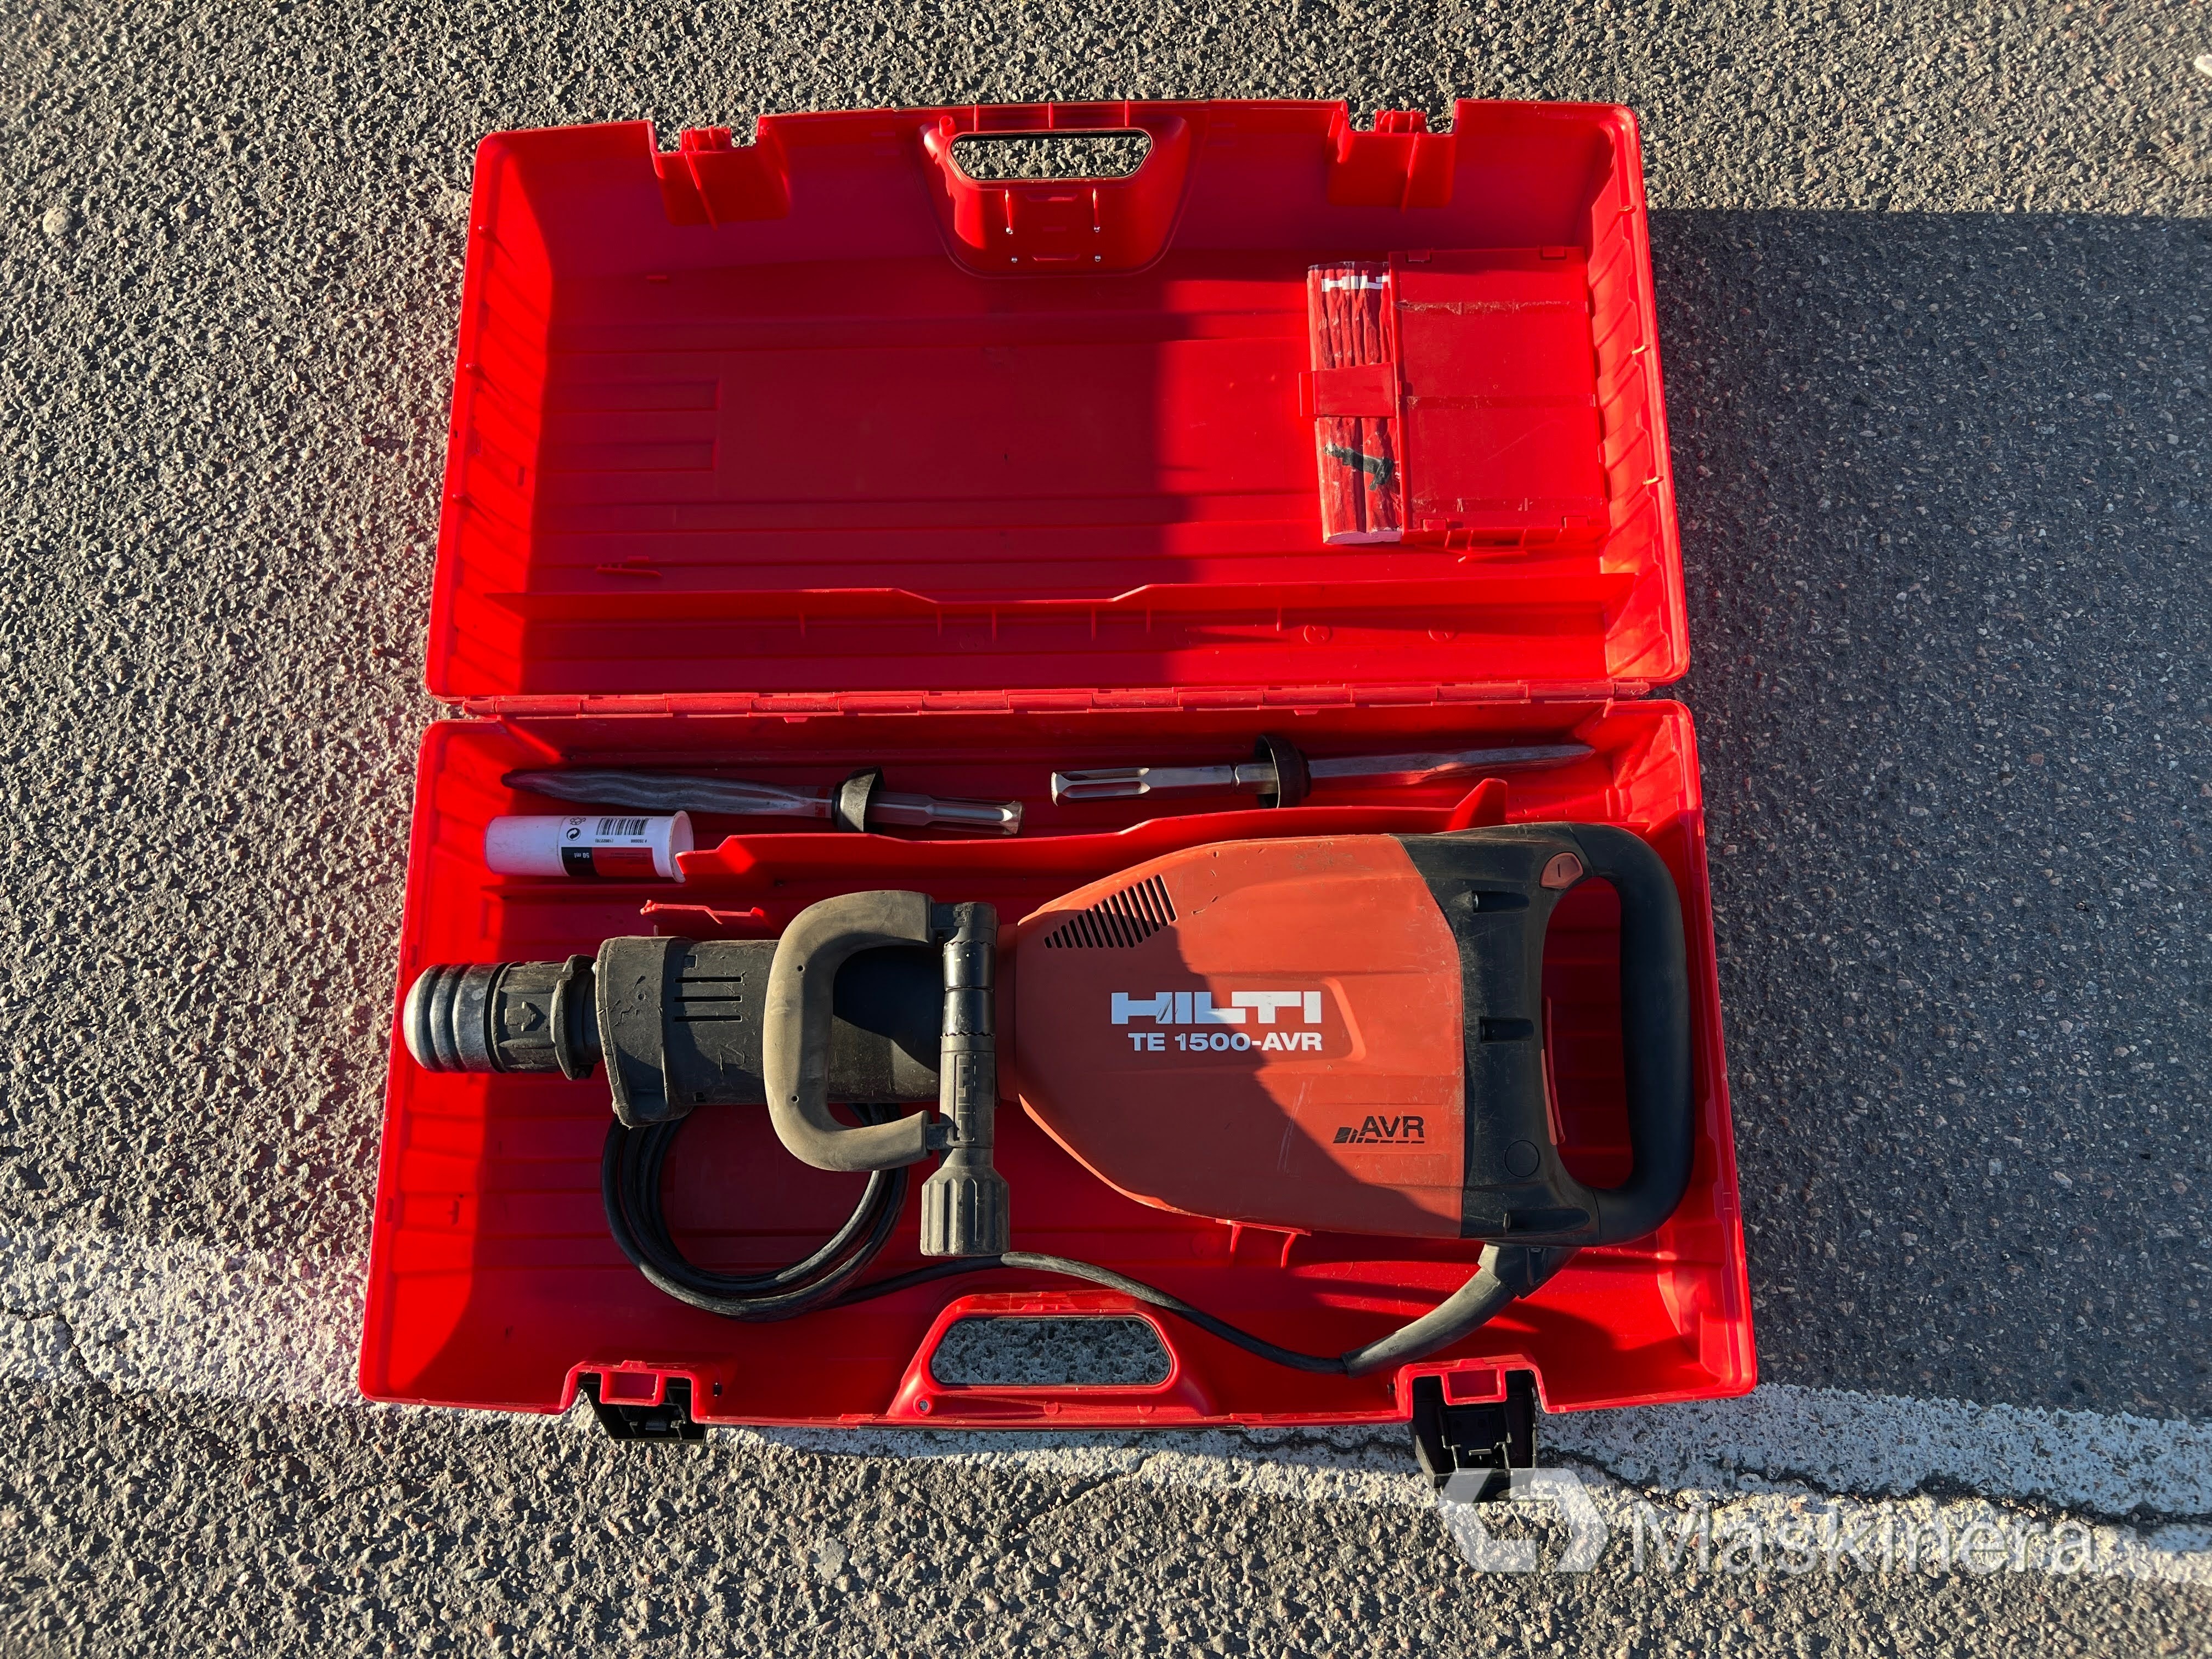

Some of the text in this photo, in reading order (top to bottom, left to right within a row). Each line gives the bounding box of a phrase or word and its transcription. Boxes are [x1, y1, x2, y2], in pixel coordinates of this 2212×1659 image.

[1321, 275, 1390, 292] HIL
[1111, 991, 1322, 1024] HILTI
[1127, 1032, 1323, 1052] TE 1500-AVR
[1359, 1115, 1425, 1139] AVR
